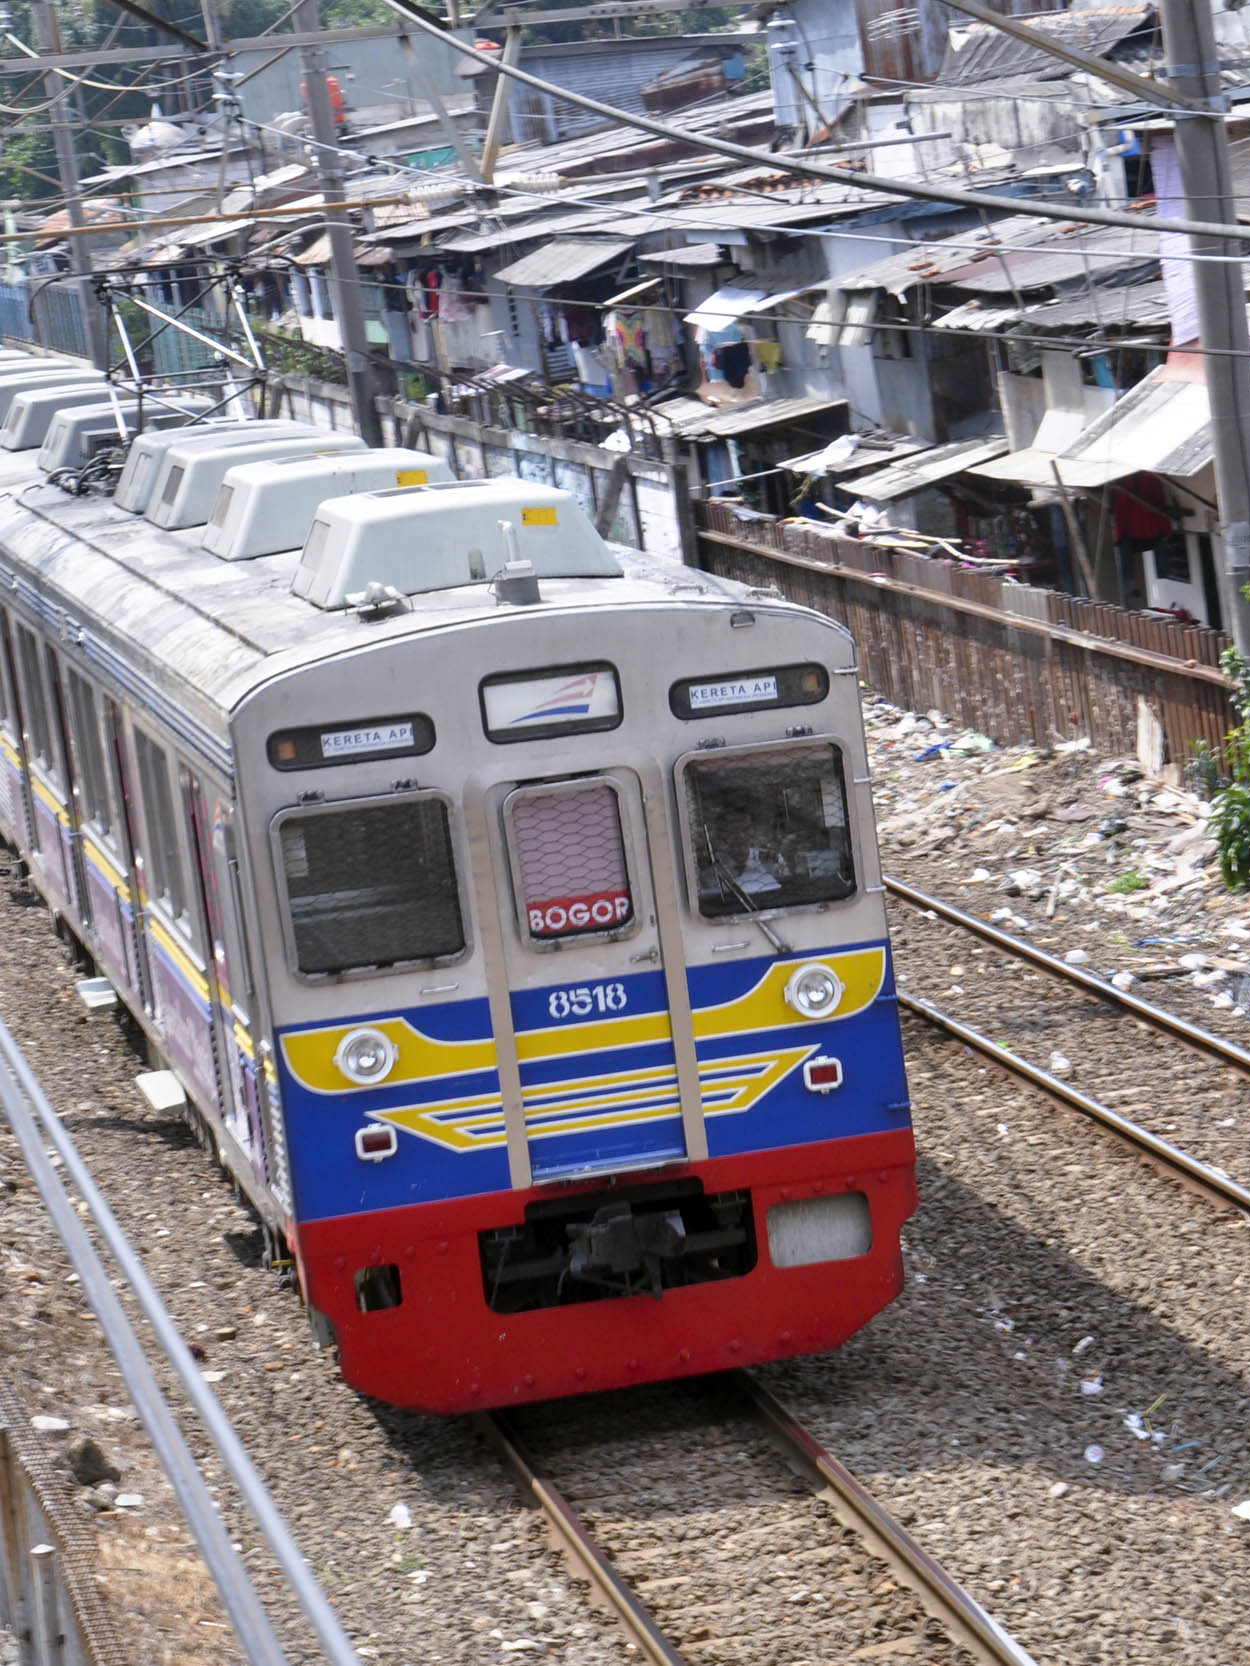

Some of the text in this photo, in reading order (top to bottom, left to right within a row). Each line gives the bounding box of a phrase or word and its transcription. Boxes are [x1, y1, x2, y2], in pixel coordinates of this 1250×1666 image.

[690, 684, 746, 700] KERETA
[754, 682, 777, 693] API
[323, 731, 382, 747] KERETA
[389, 727, 414, 739] API
[529, 897, 629, 932] BOGOR
[549, 983, 627, 1019] 8518
